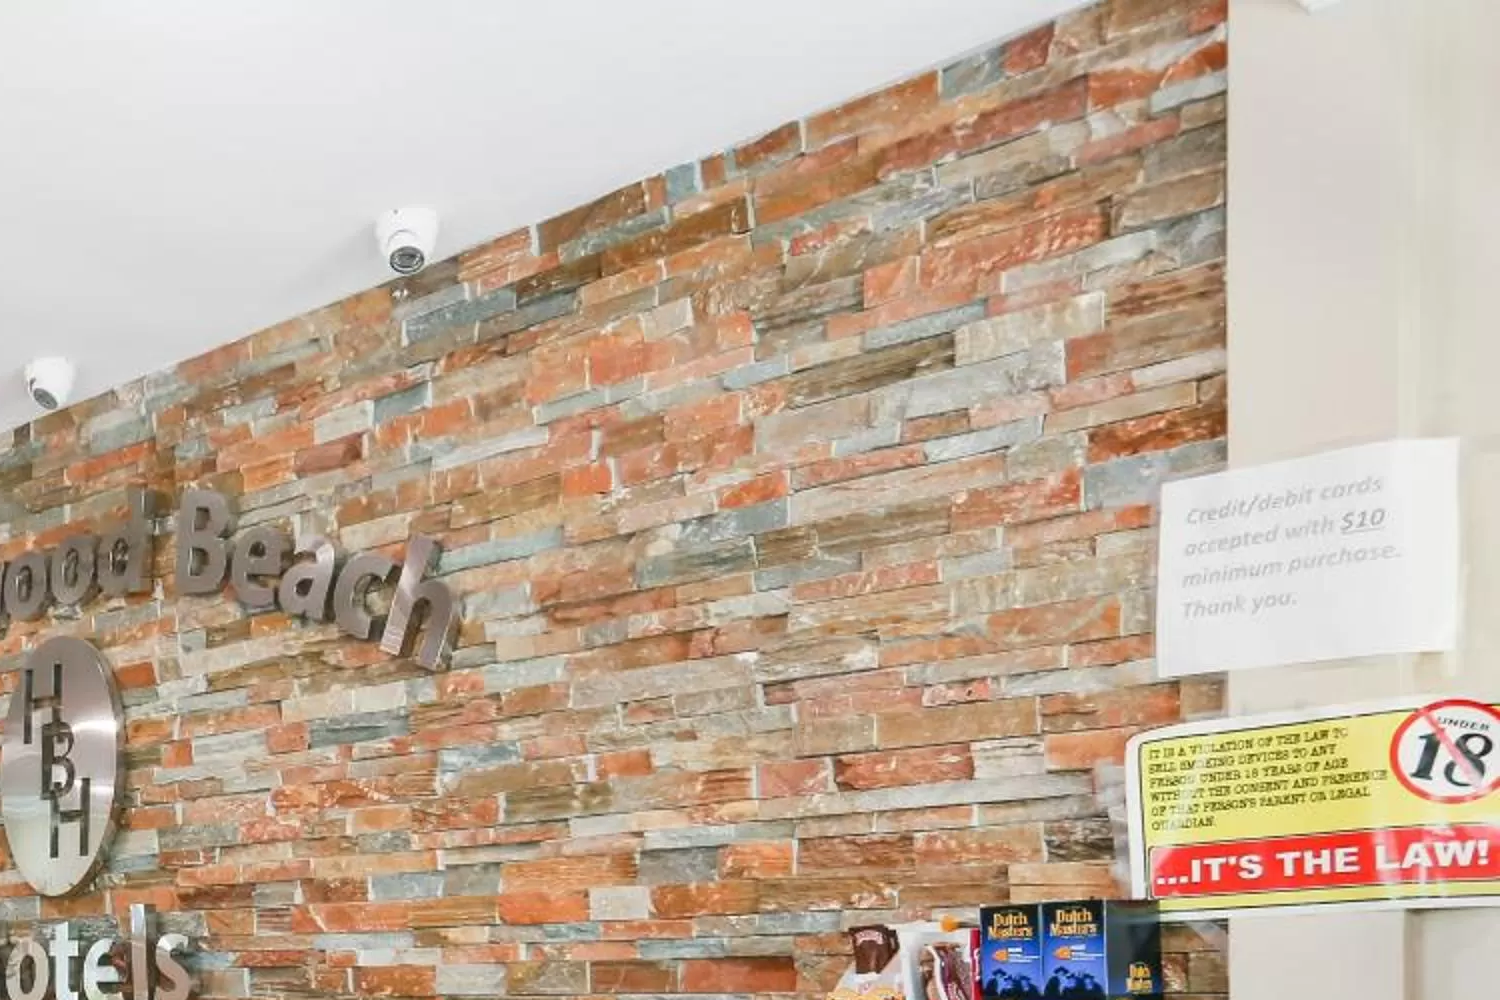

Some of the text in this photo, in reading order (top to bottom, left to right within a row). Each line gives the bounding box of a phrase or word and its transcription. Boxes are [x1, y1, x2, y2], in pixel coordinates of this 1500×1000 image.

[1187, 475, 1382, 525] Credit/debit cards
[1184, 508, 1387, 557] accepted with $10
[174, 488, 453, 673] Beach
[1182, 545, 1402, 588] minimum purchase.
[1182, 591, 1297, 619] Thank you.
[1436, 715, 1490, 731] UNDER
[1177, 746, 1186, 757] A
[1257, 735, 1273, 747] OF
[1275, 732, 1300, 746] THE
[1303, 729, 1329, 742] LAW
[1148, 763, 1176, 775] SELL
[1238, 750, 1289, 765] DEVICES
[1292, 748, 1307, 760] TO
[1310, 744, 1336, 757] ANY
[1200, 770, 1240, 784] UNDER
[1245, 767, 1259, 780] 18
[1263, 763, 1301, 777] YEARS
[1305, 761, 1320, 774] OF
[1323, 757, 1348, 770] AGE
[1409, 732, 1493, 787] 18
[1208, 785, 1231, 798] THE
[1234, 779, 1289, 795] CONSENT
[1292, 776, 1319, 789] AND
[1151, 806, 1167, 818] OF
[1310, 790, 1327, 803] OR
[1330, 787, 1370, 801] LEGAL
[1276, 847, 1360, 877] THE
[1375, 839, 1490, 870] LAW!
[993, 911, 1028, 926] Dutch
[1050, 922, 1098, 937] Masters
[1056, 908, 1092, 923] Dutch
[988, 924, 1033, 939] Masters
